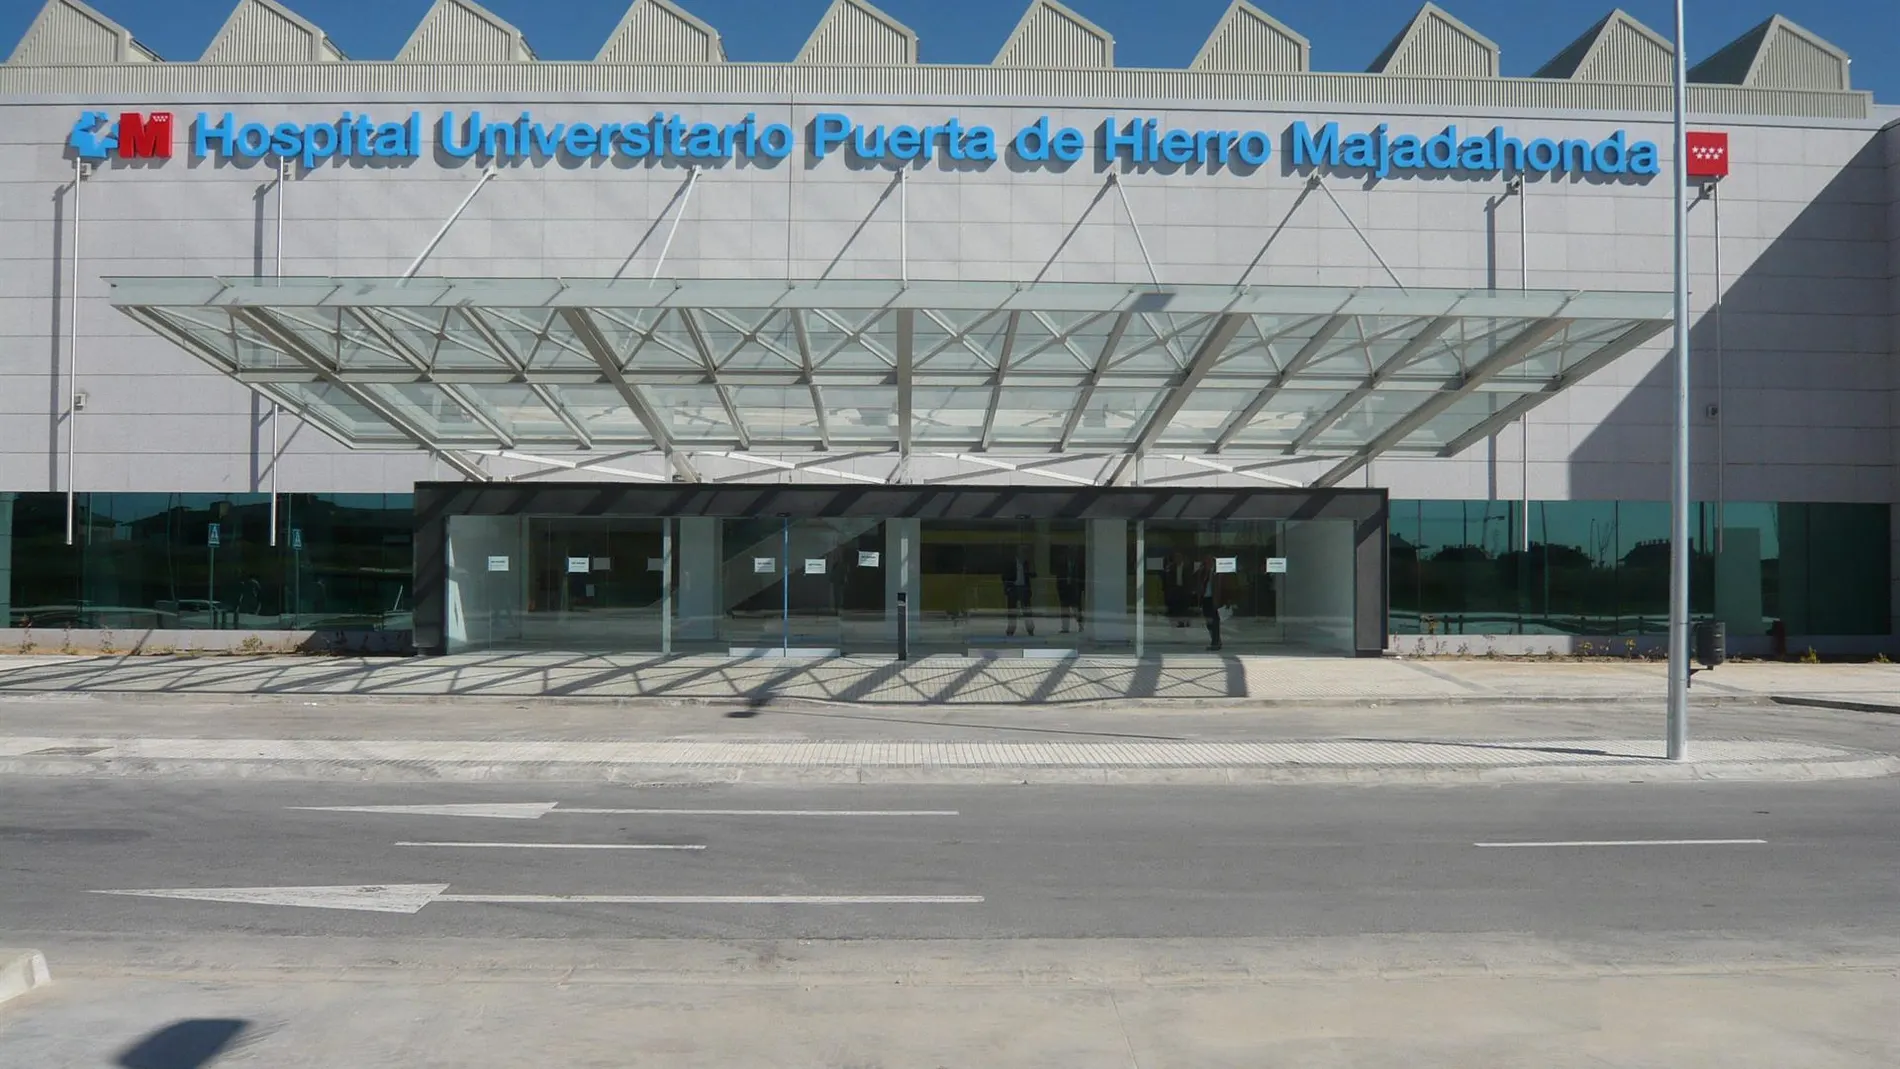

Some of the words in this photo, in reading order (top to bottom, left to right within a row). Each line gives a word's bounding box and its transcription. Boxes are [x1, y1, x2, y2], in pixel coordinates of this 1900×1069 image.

[119, 112, 173, 158] M
[194, 111, 420, 168] Hospital
[441, 111, 793, 159] Universitario
[814, 112, 997, 160] Puerta
[1015, 115, 1083, 161] de
[1105, 117, 1270, 165] Hierro
[1292, 121, 1660, 177] Majadahonda
